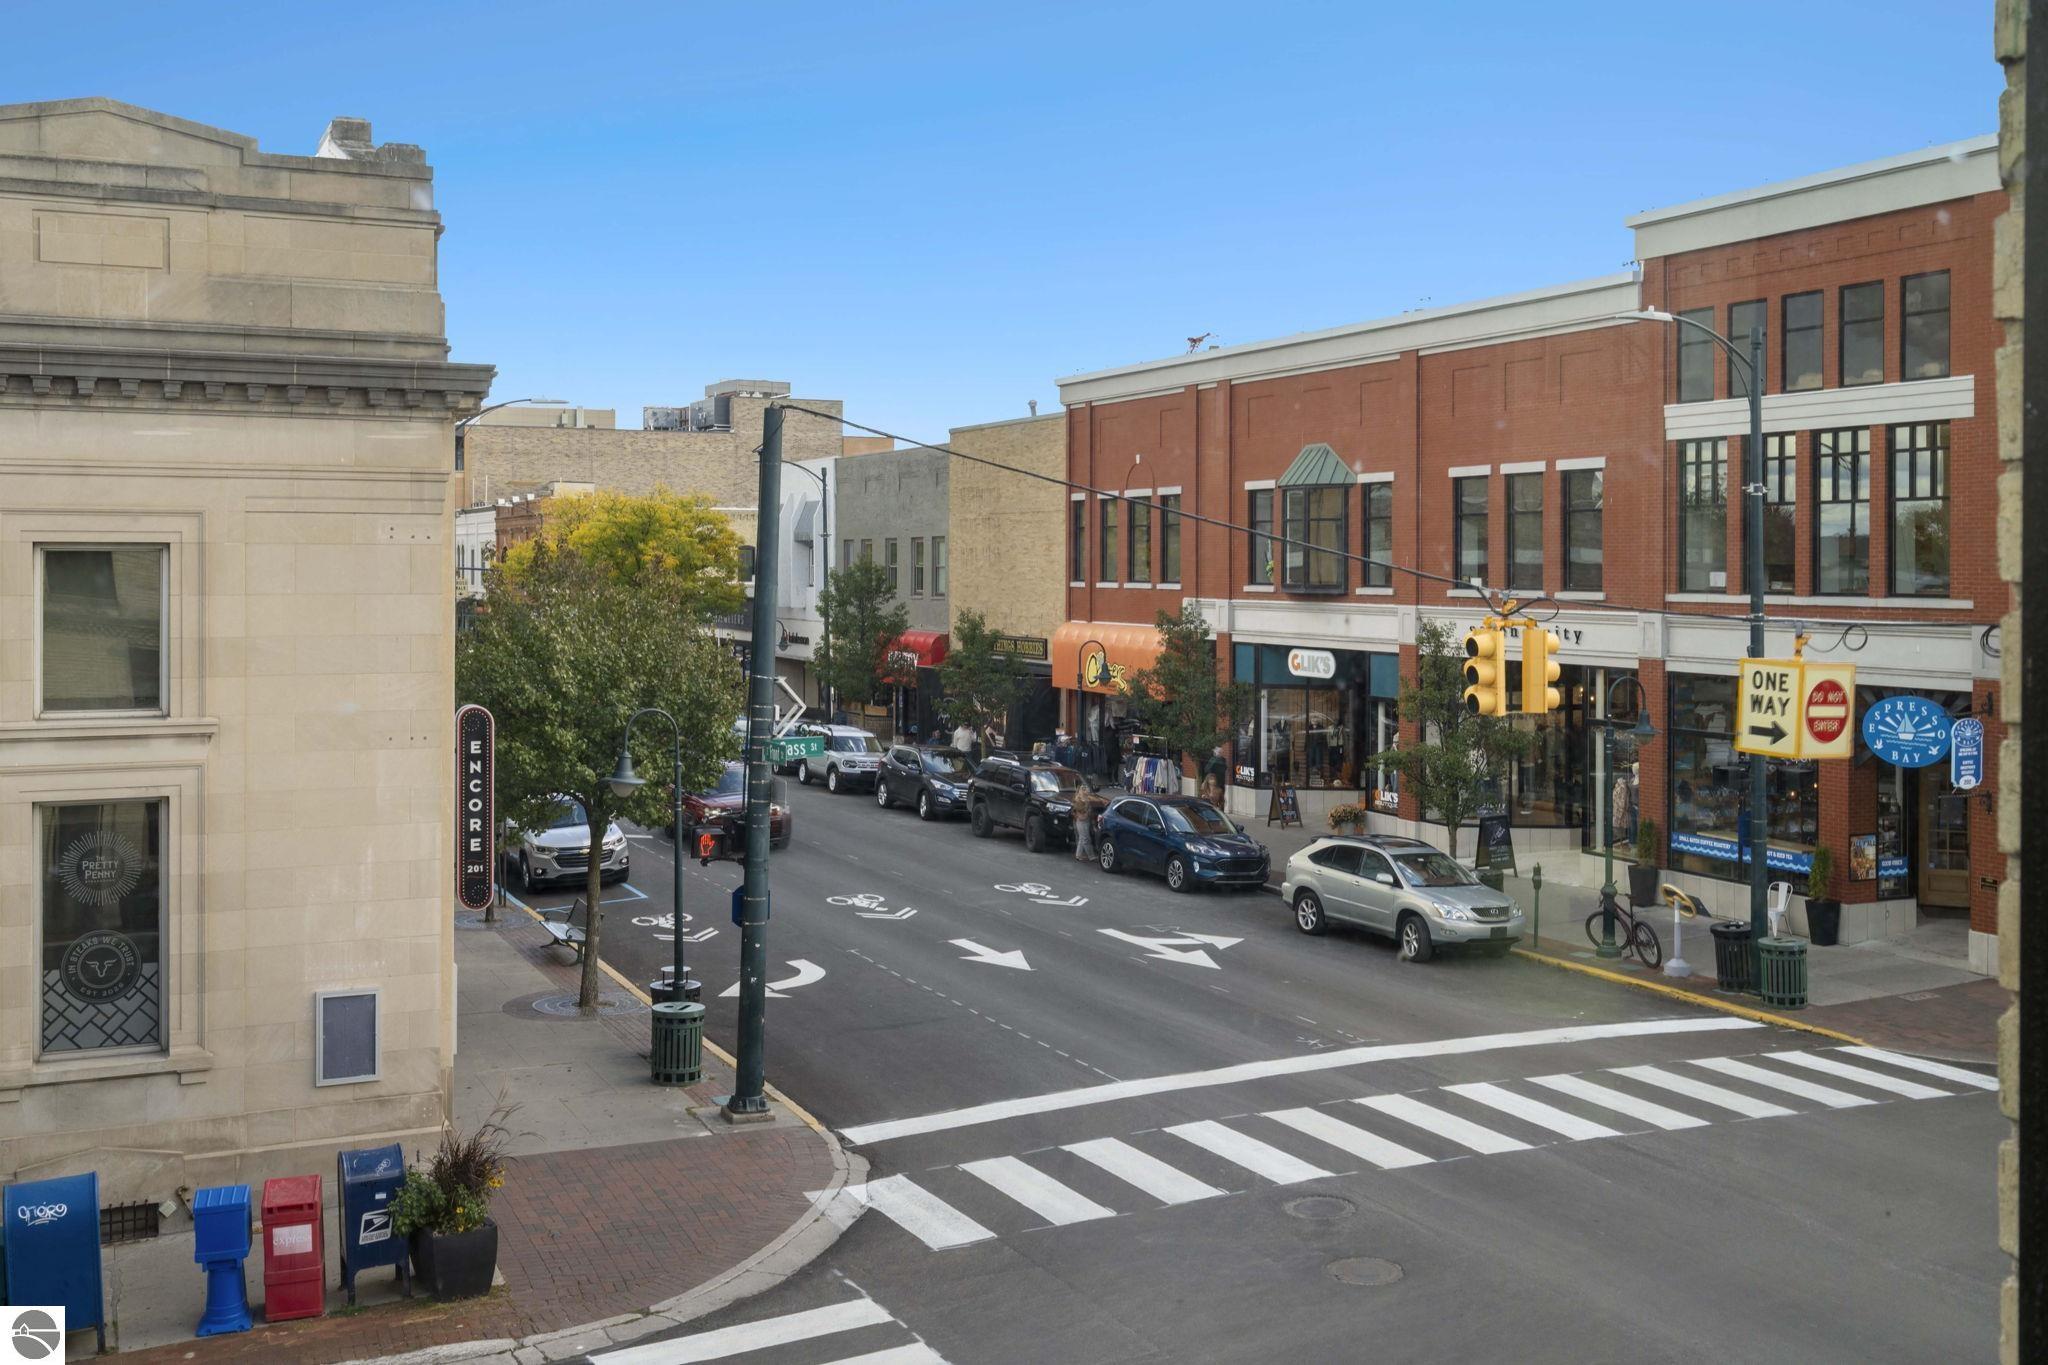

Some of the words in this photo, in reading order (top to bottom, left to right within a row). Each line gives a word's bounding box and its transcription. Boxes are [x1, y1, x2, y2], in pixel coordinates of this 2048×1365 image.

[1016, 640, 1044, 655] HOBBIES
[1291, 653, 1332, 674] GLIK'S
[1752, 670, 1790, 693] ONE
[1812, 691, 1824, 703] DO
[1827, 691, 1845, 703] NOT
[1750, 693, 1791, 717] WAY
[1813, 720, 1840, 732] ENTER
[1868, 700, 1946, 740] ESPRESSO
[780, 741, 807, 756] ass
[810, 742, 818, 752] St
[1891, 750, 1921, 764] BAY
[1235, 765, 1255, 777] GLIK'S
[468, 740, 483, 852] ENCORE
[1374, 788, 1399, 804] GLIK'S
[82, 860, 119, 870] PRETTY
[467, 864, 484, 873] 201
[84, 869, 117, 880] PENNY
[102, 935, 117, 946] WE
[118, 942, 135, 966] TRUST
